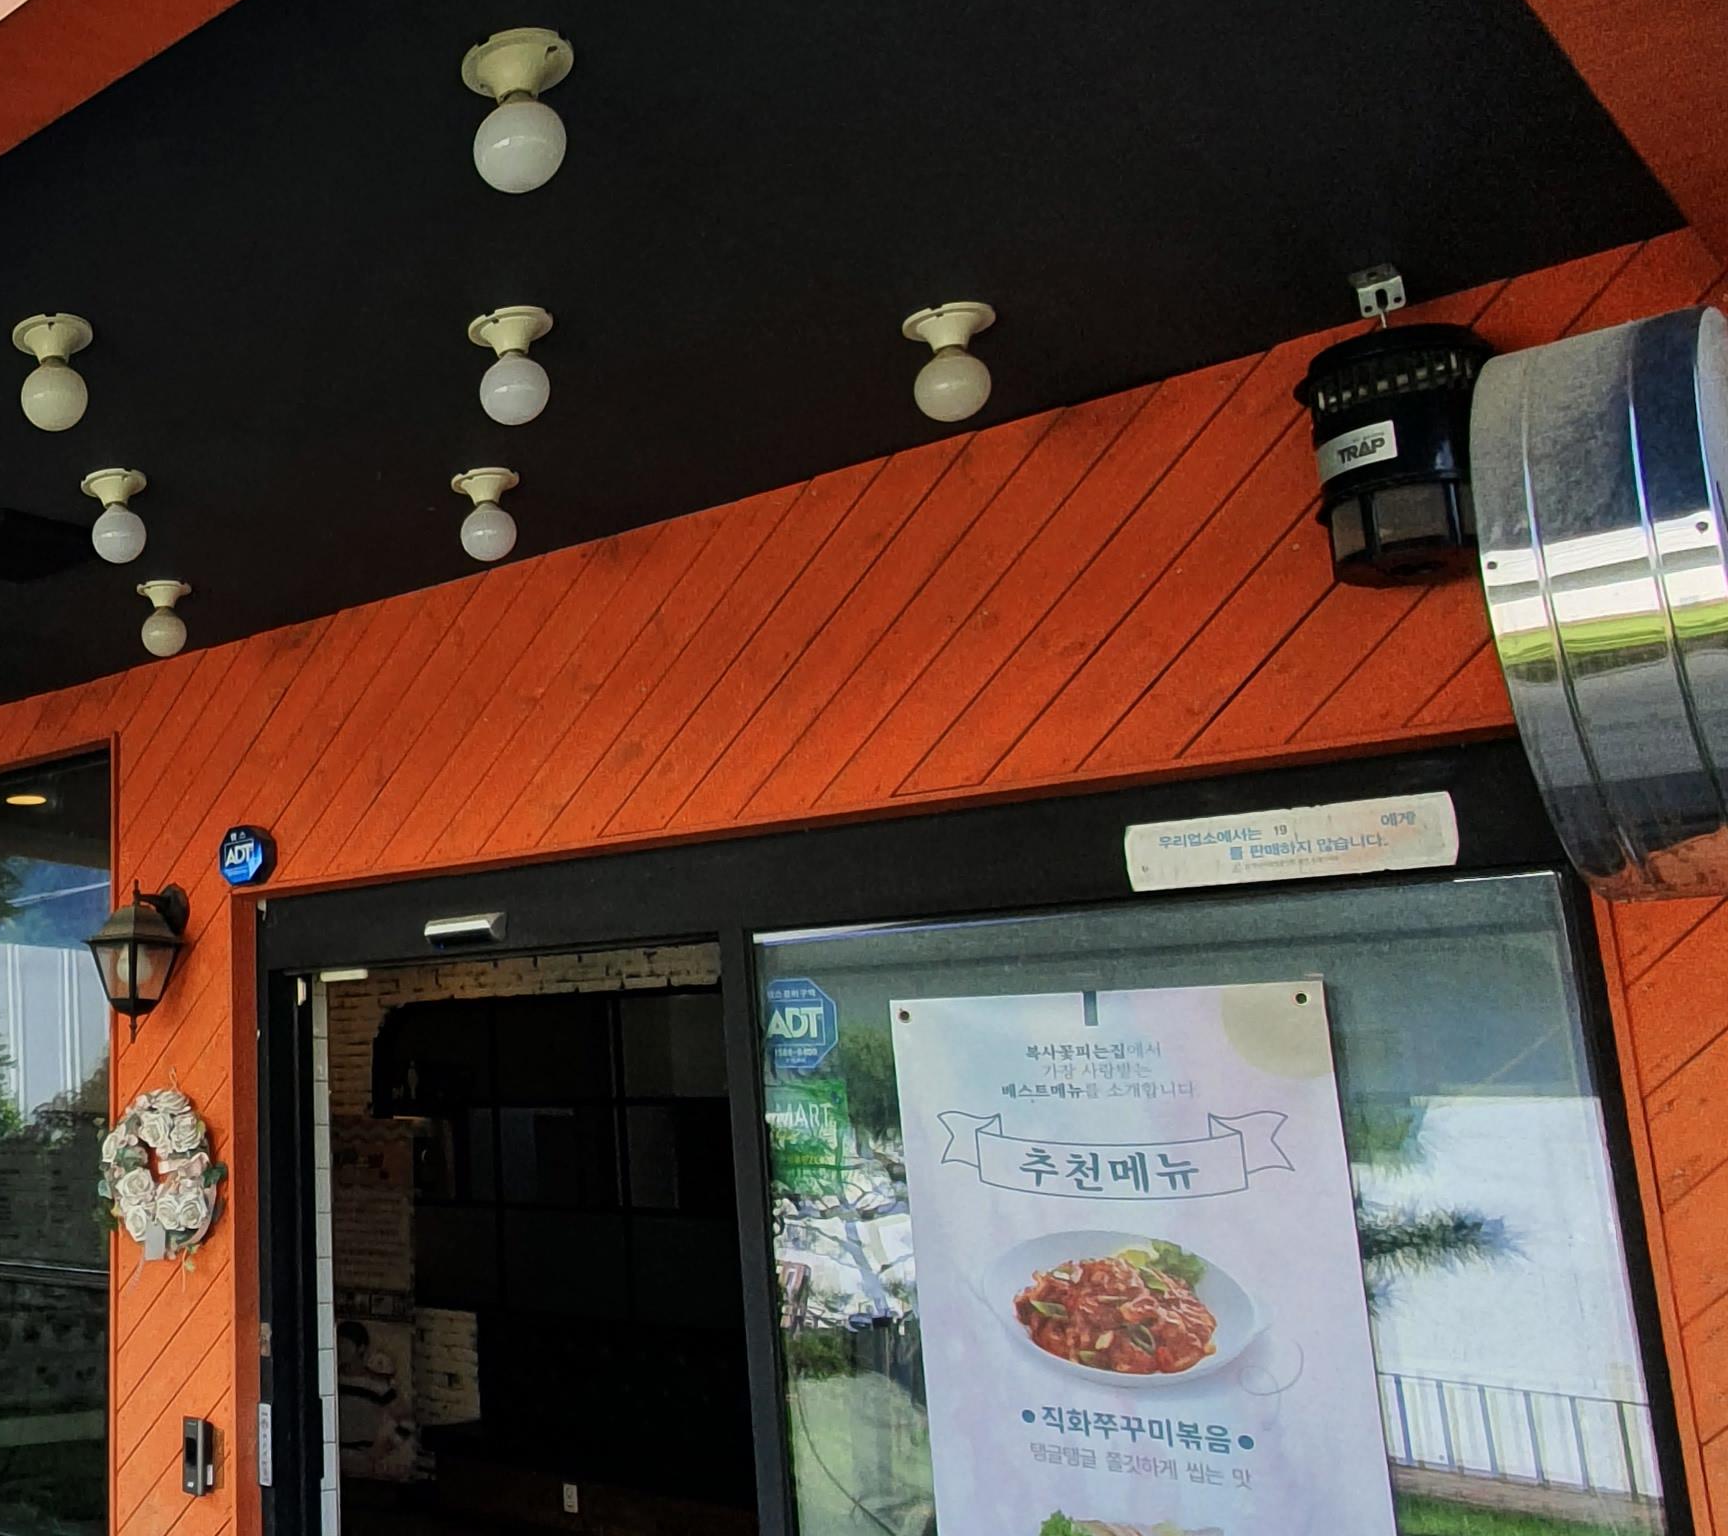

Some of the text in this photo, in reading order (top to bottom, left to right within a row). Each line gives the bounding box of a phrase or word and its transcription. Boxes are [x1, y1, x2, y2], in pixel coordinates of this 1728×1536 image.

[1337, 437, 1385, 464] TRAP
[1158, 825, 1263, 850] 우리업소에서는
[1273, 824, 1288, 837] 19
[1249, 838, 1312, 859] 판매하지
[224, 842, 254, 867] ADT
[766, 1006, 824, 1039] ADT
[1026, 1041, 1161, 1062] 복사꽃피는집에서
[1043, 1063, 1075, 1080] 가장
[1019, 1146, 1200, 1194] 추천메뉴
[1041, 1405, 1232, 1455] 직화쭈꾸미볶음
[1231, 1467, 1253, 1490] 맛
